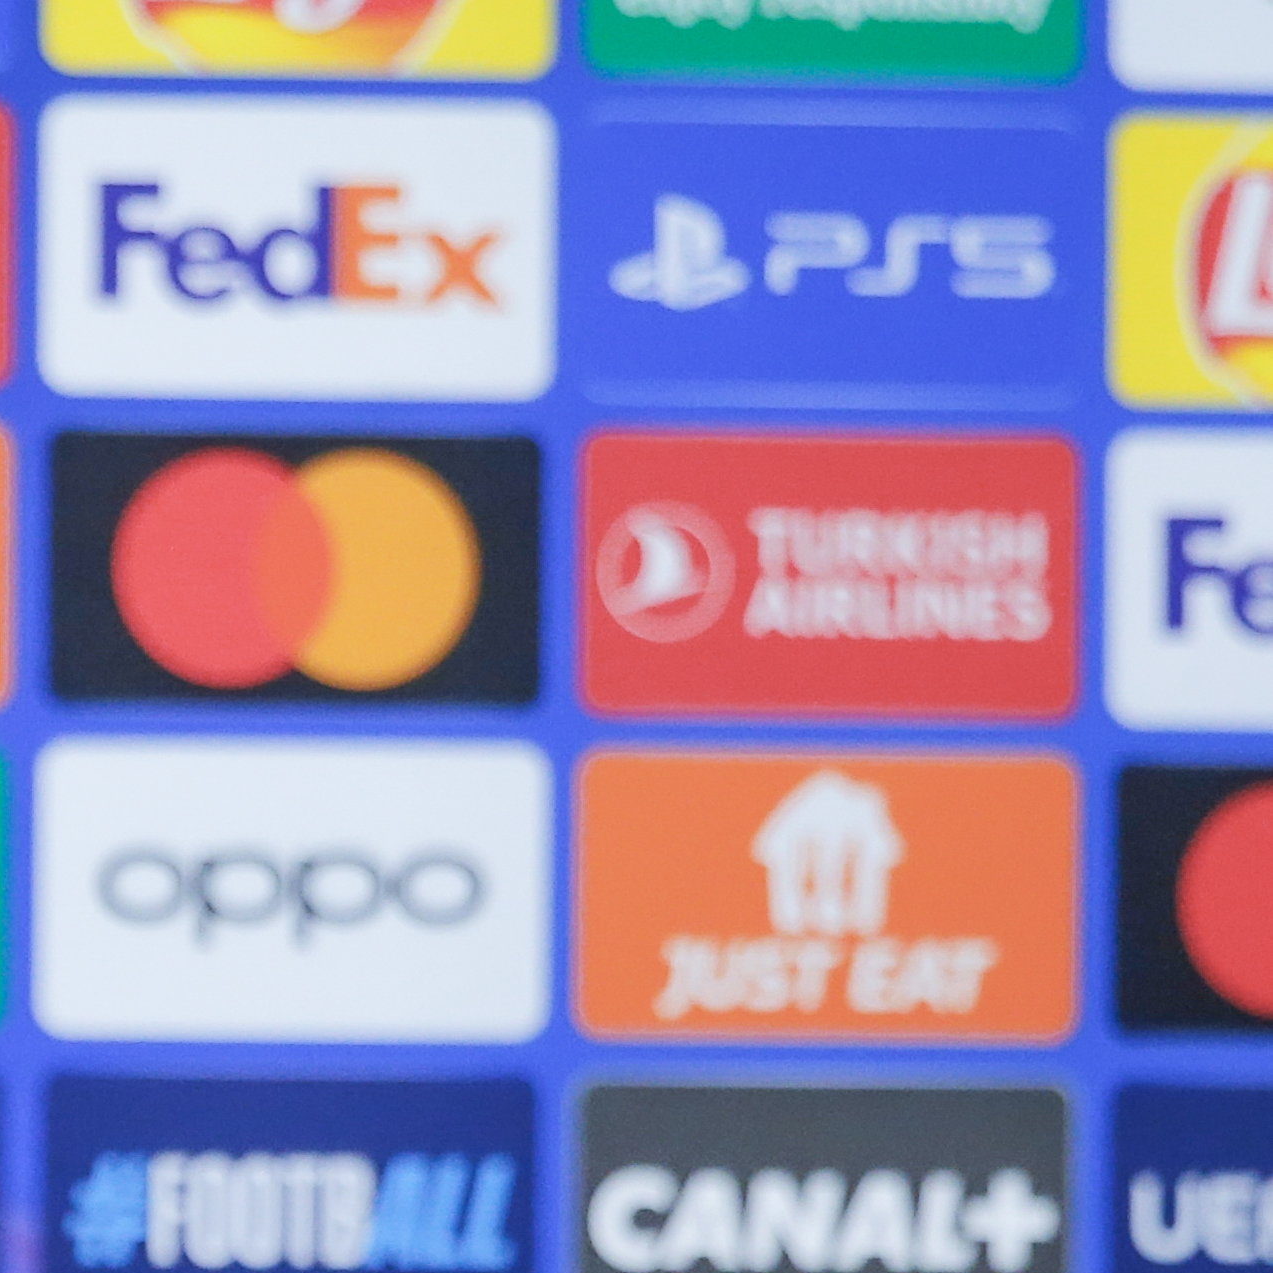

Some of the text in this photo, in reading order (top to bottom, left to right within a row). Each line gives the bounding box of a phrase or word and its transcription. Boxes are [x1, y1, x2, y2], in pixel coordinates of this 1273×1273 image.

[96, 179, 496, 307] FedEx
[764, 213, 1055, 298] PS5
[749, 507, 1048, 576] TURKISH
[744, 578, 1051, 641] AIRLINES
[95, 846, 491, 947] oppo
[654, 936, 997, 1020] JUST EAT
[68, 1152, 510, 1269] #FOOTBALL
[588, 1166, 1059, 1272] CANAL+
